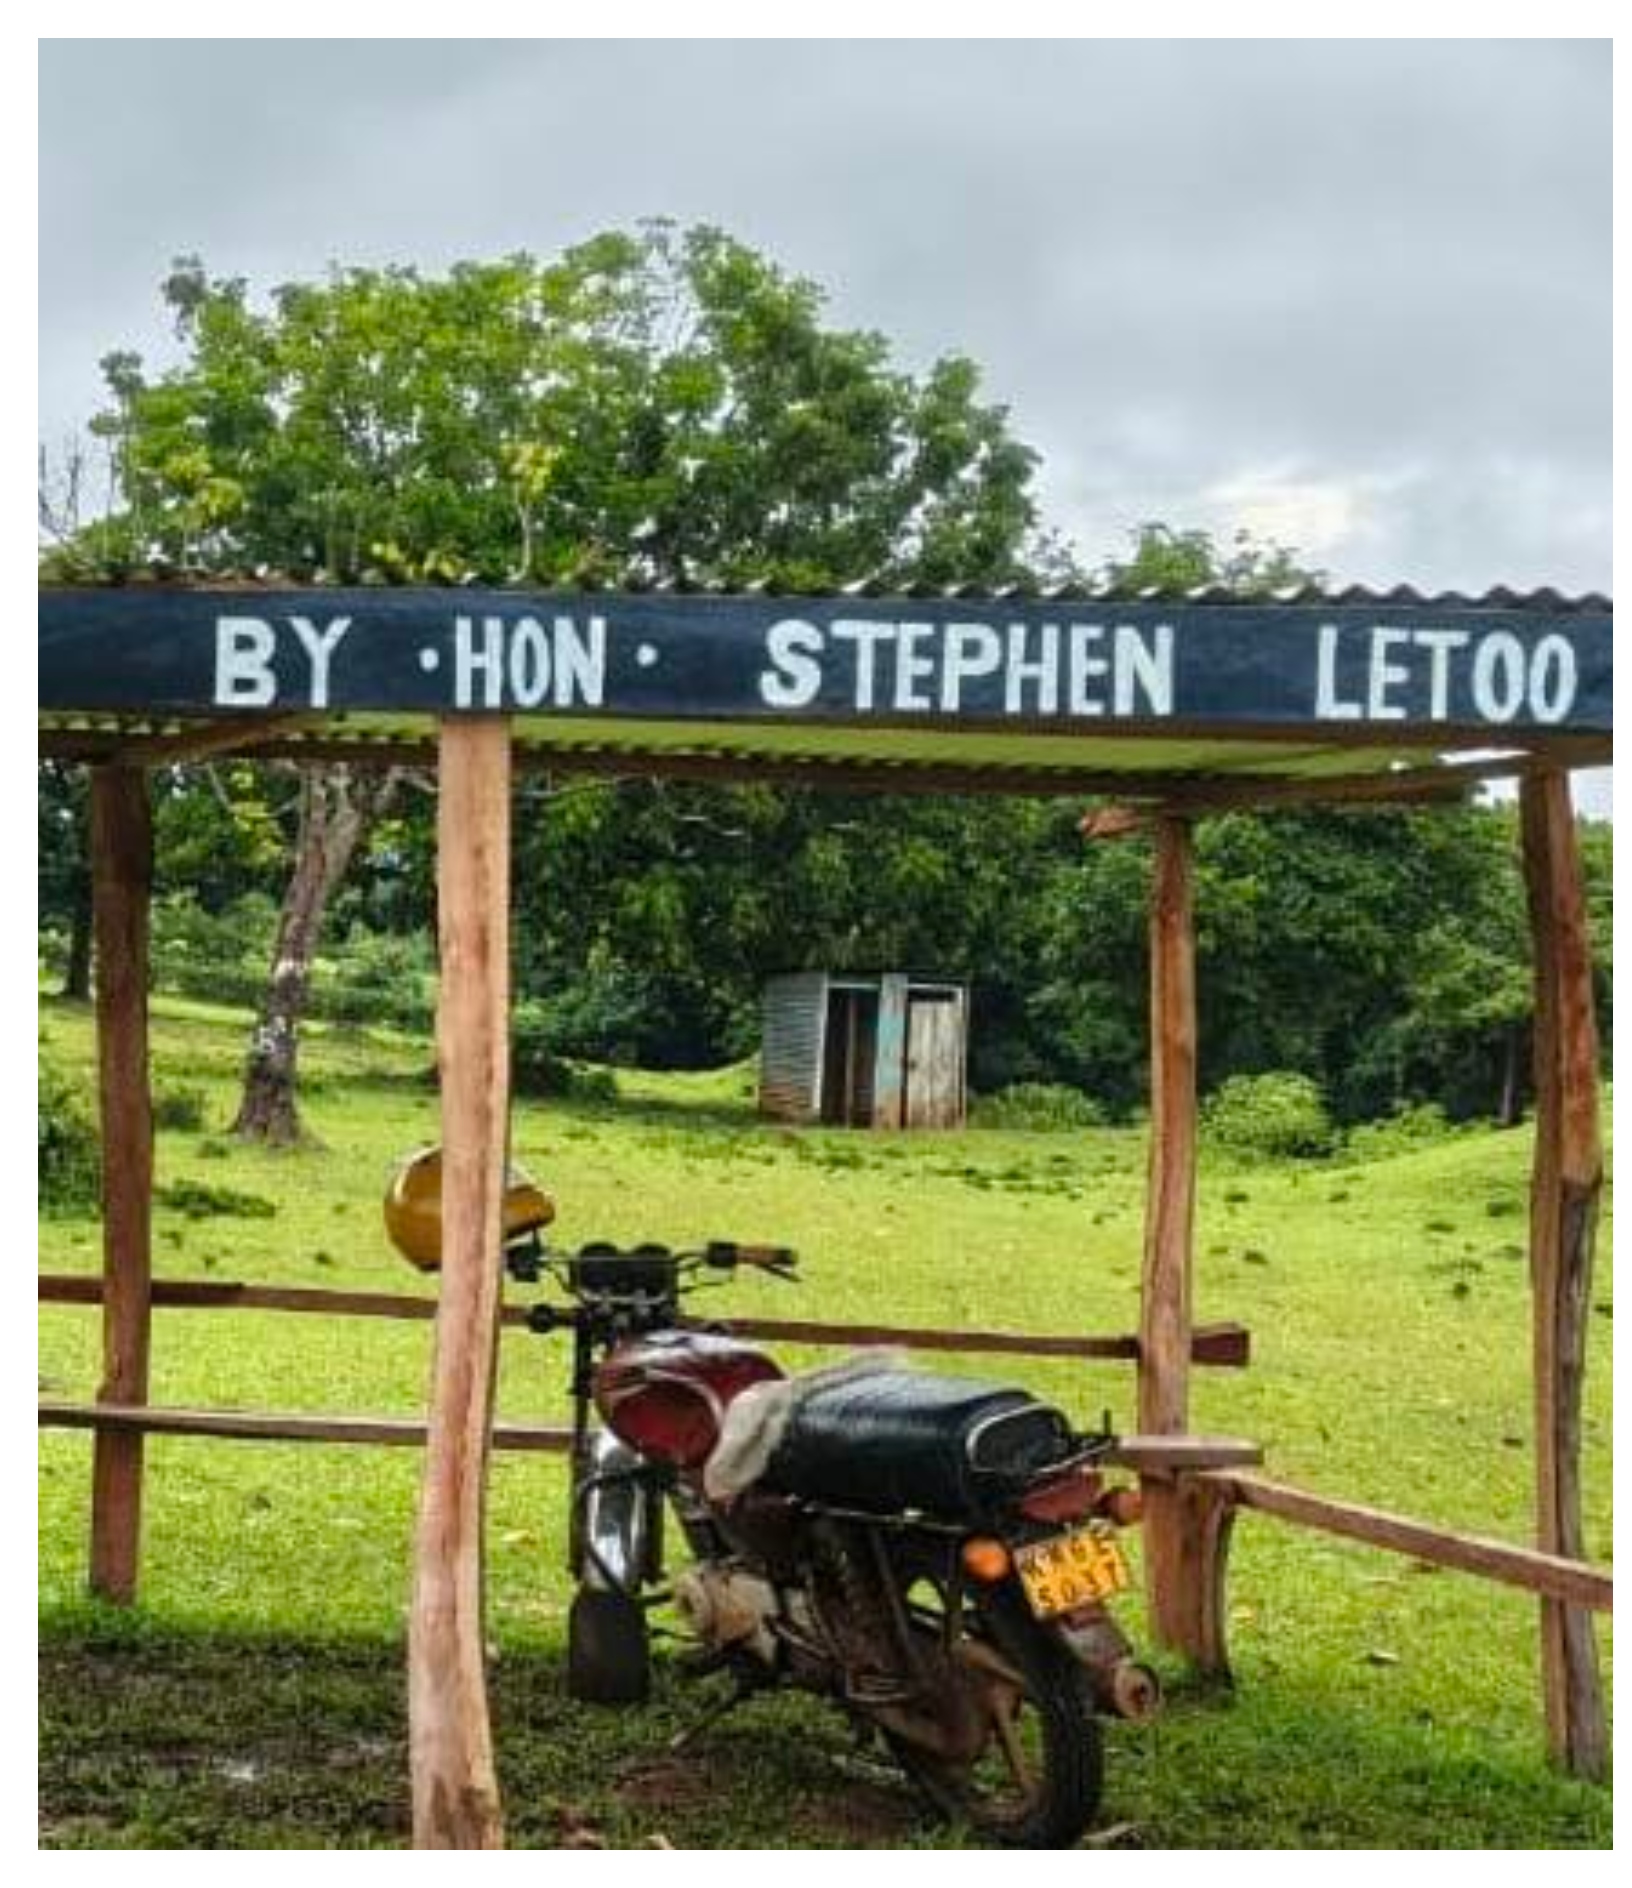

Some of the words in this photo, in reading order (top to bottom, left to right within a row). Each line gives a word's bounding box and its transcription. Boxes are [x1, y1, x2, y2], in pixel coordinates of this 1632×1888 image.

[213, 616, 352, 709] BY
[759, 618, 1175, 717] STEPHEN
[1314, 625, 1578, 724] LETOO
